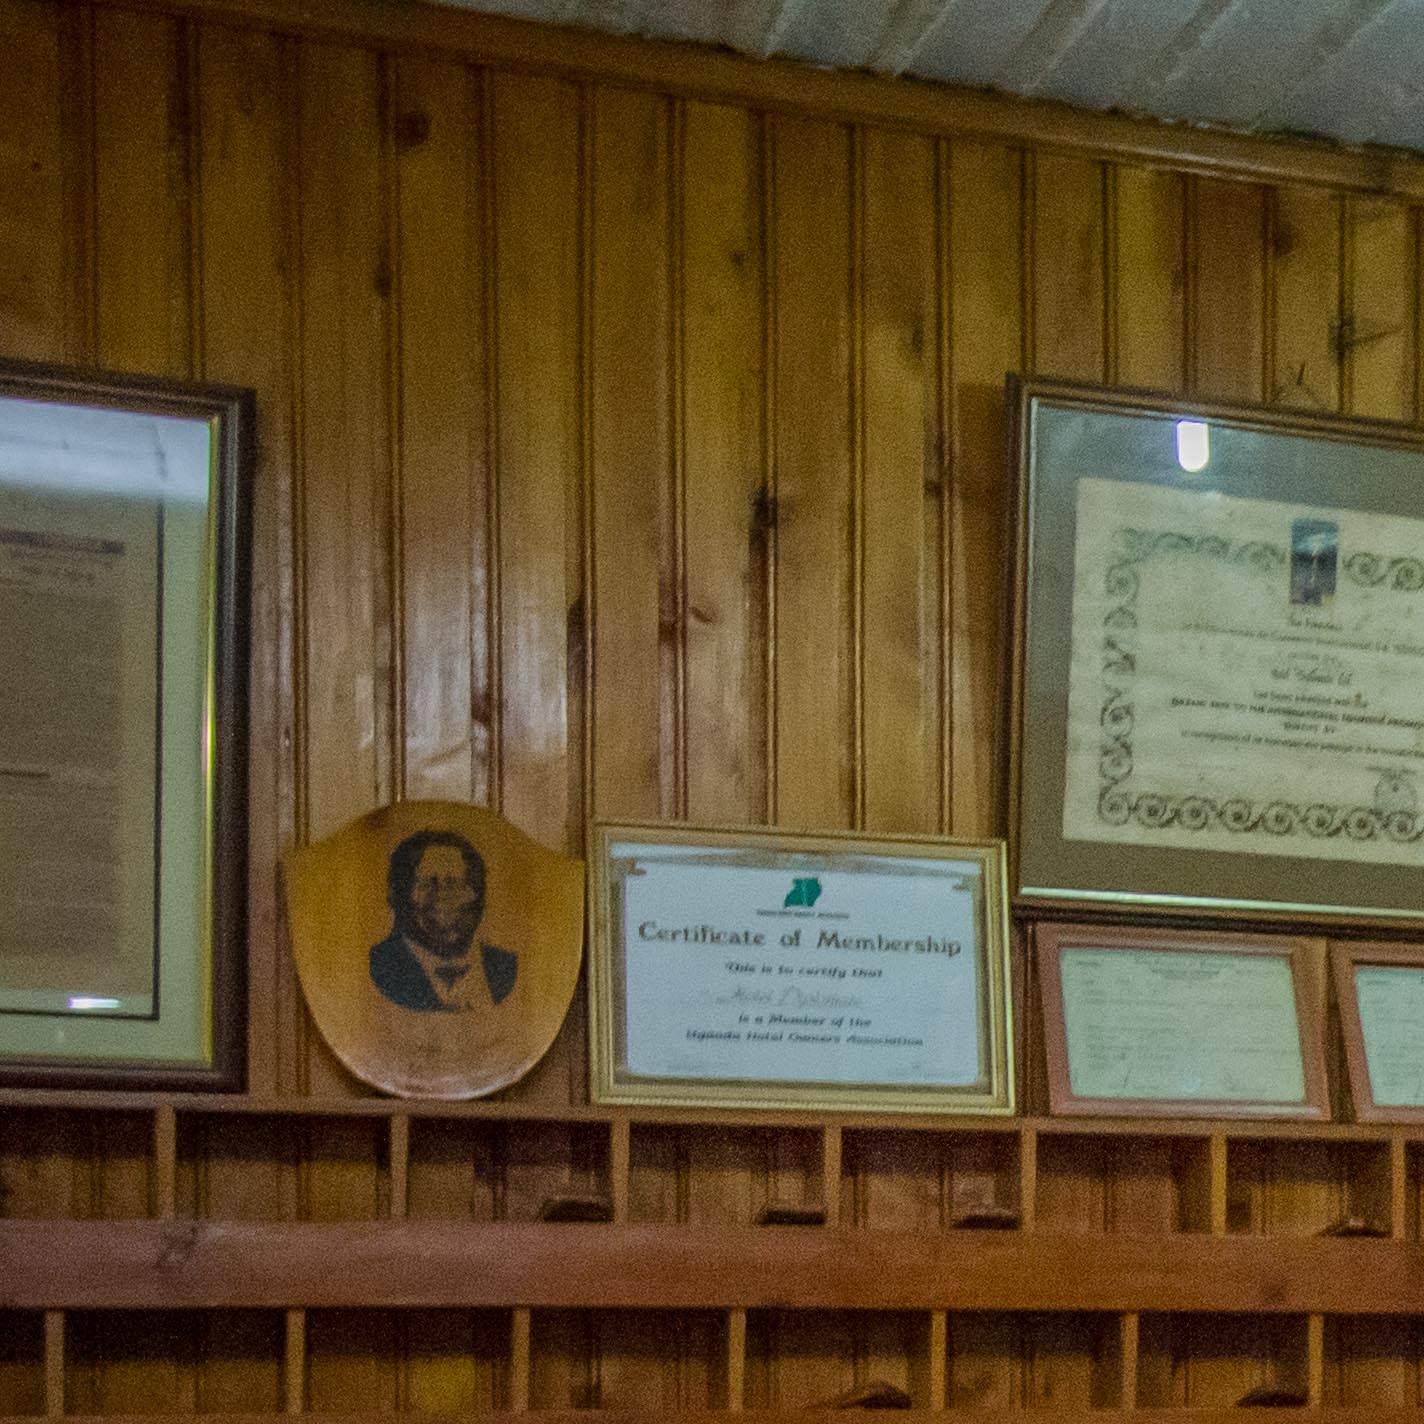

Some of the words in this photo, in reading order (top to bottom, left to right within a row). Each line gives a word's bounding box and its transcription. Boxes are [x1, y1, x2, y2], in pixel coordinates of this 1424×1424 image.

[638, 920, 766, 946] Certificate
[780, 929, 801, 948] of
[816, 931, 961, 957] Membership
[726, 961, 756, 974] This
[761, 964, 772, 974] is
[799, 965, 847, 979] certify
[852, 967, 882, 978] that
[768, 1014, 826, 1026] Member
[850, 1017, 872, 1028] the
[686, 1029, 741, 1041] Uganda
[846, 1034, 923, 1046] Association
